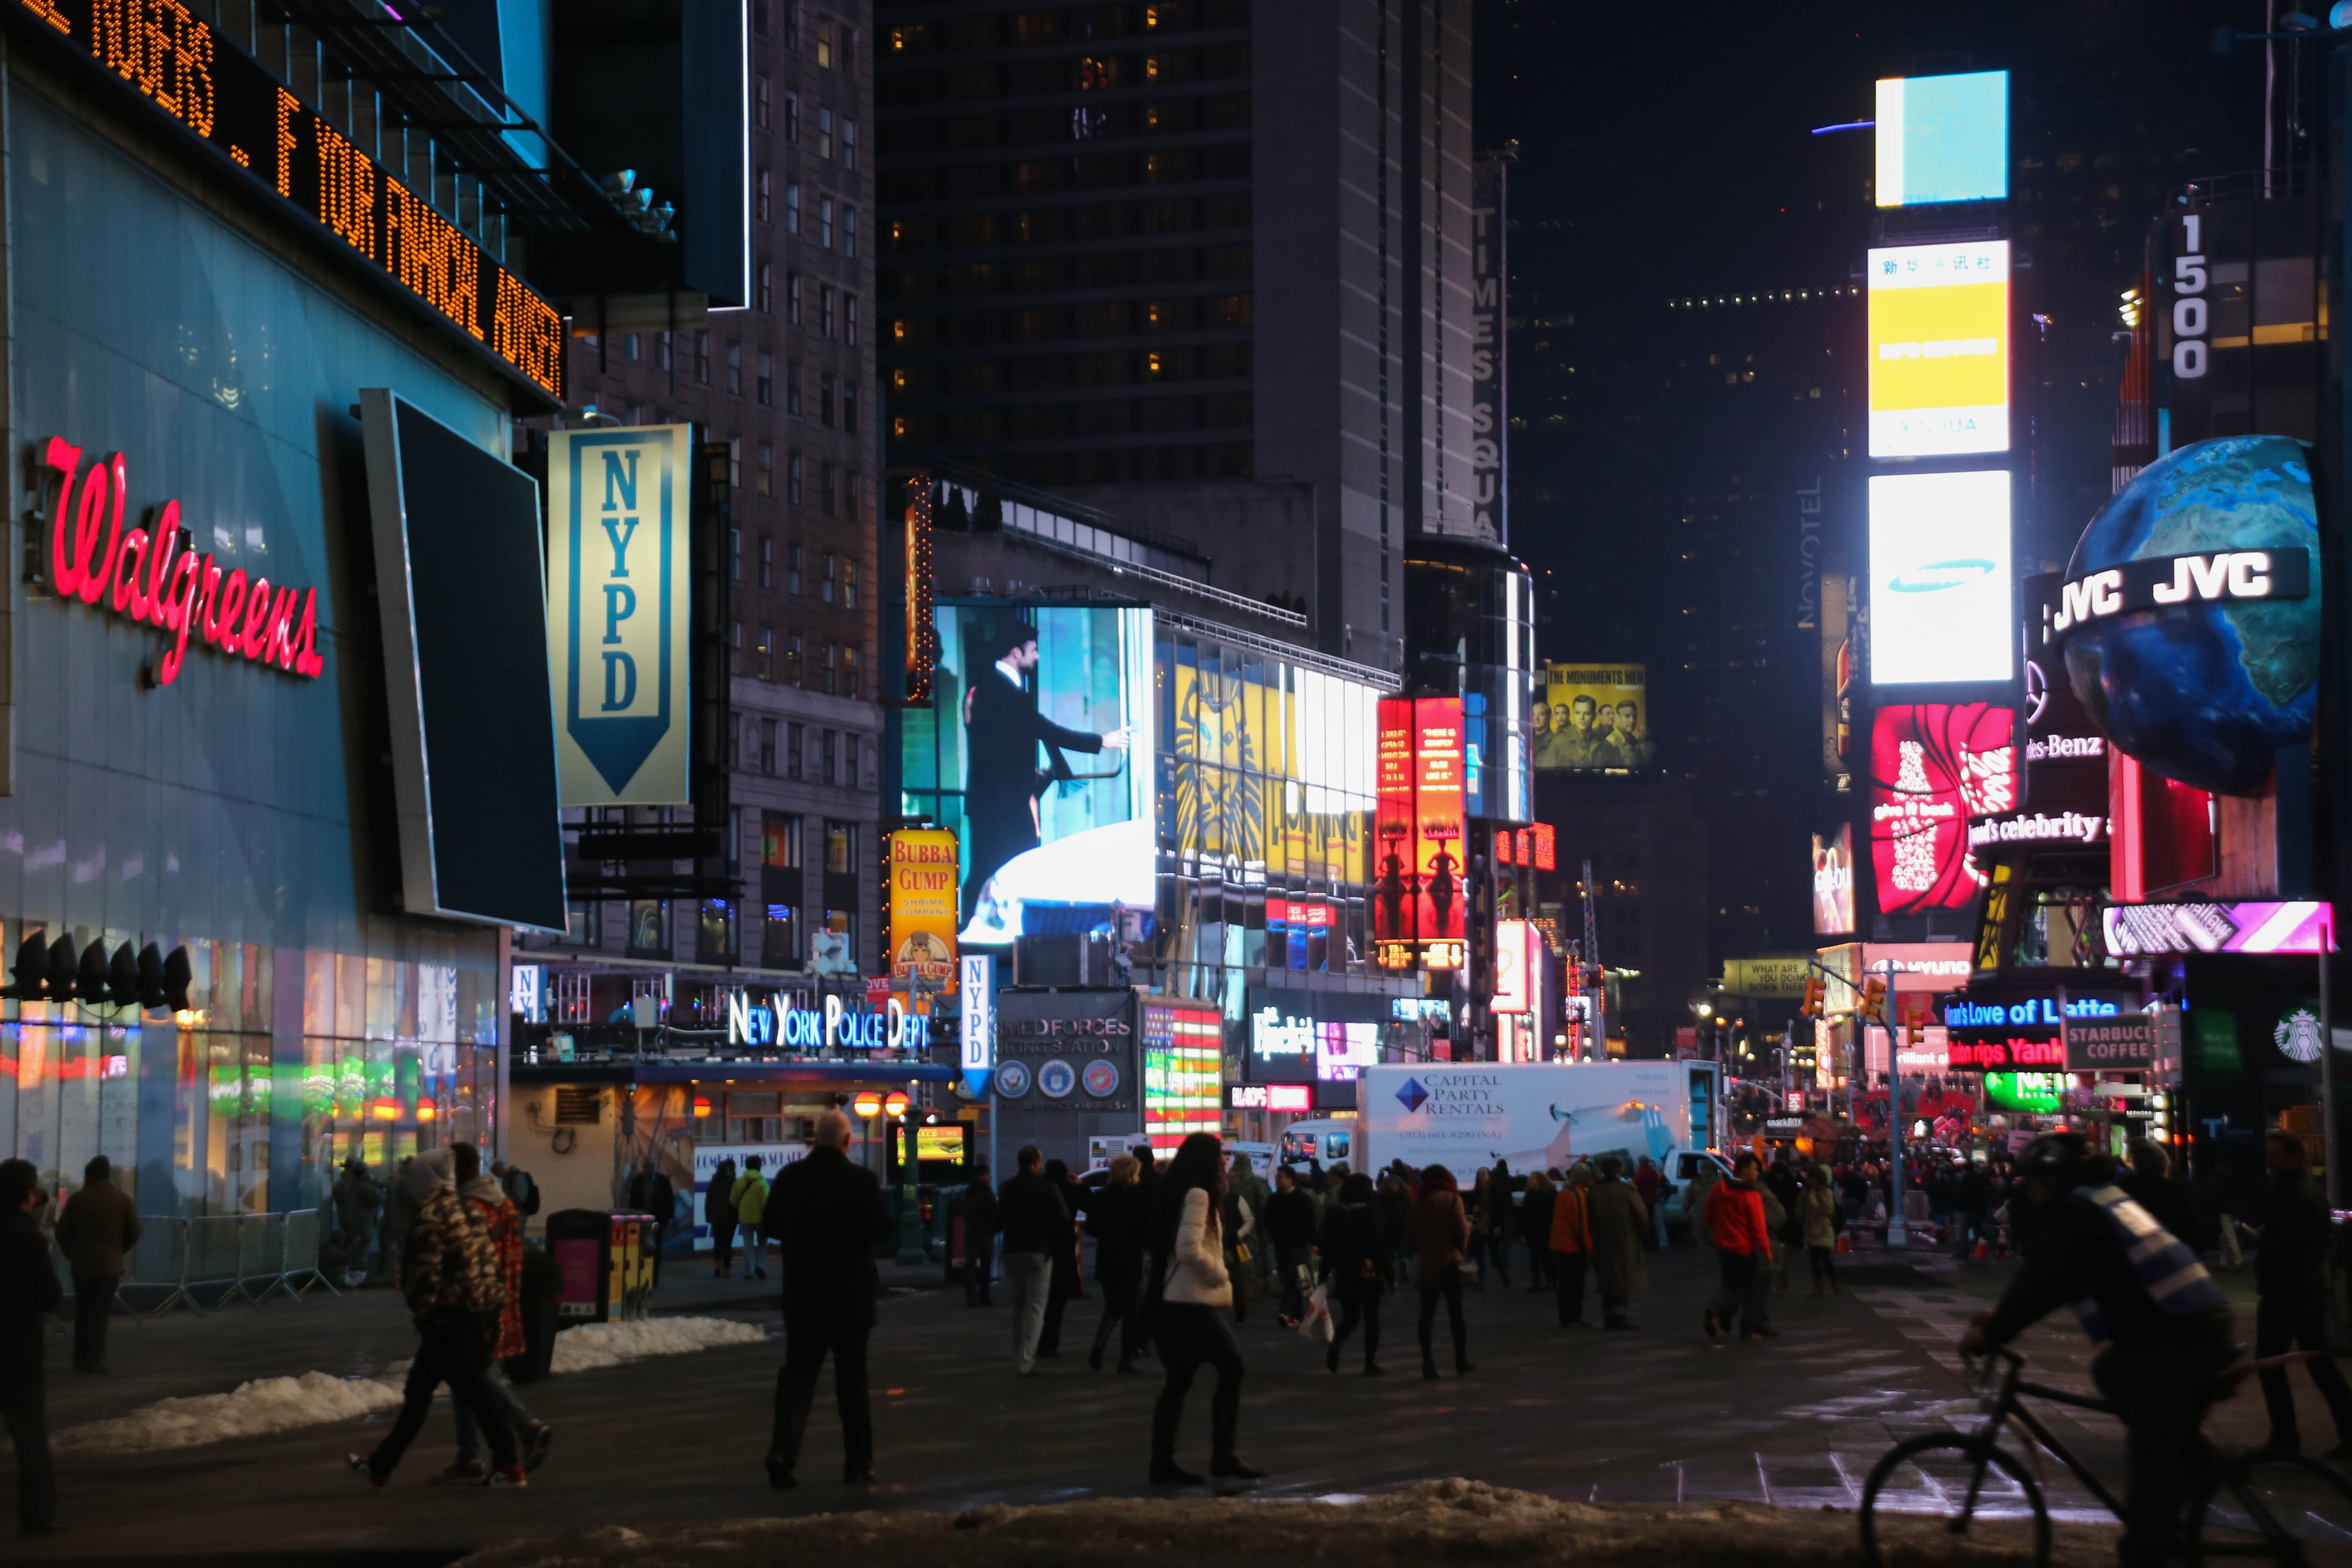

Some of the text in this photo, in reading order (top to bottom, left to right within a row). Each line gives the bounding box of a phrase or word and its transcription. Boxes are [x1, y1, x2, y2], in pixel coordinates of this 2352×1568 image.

[314, 116, 375, 260] YOUR
[386, 175, 484, 341] FINANCIAL
[1472, 208, 1497, 380] TIMES
[2174, 215, 2207, 378] 1500
[47, 436, 323, 685] Walgreens
[1797, 475, 1821, 628] NOVOTEL
[602, 450, 640, 712] NYPD
[2153, 552, 2269, 603] JVC
[2054, 570, 2122, 631] JVC
[1550, 670, 1644, 684] THE MONUMENTS MEN
[2000, 812, 2102, 842] celebrity
[894, 840, 952, 864] BUBBA
[899, 867, 949, 891] GUMP
[927, 962, 952, 976] GUMP
[1752, 965, 1798, 973] WHAT ARE
[1759, 974, 1809, 982] YOU DOING
[1749, 983, 1777, 991] DOWN
[729, 992, 928, 1048] NEW YORK POLICE DEPT
[969, 959, 982, 1063] NYPD
[1968, 1001, 2005, 1025] Love
[2009, 999, 2038, 1025] of
[1051, 1018, 1131, 1035] FORCES
[2087, 1042, 2148, 1058] COFFEE
[1424, 1074, 1501, 1086] CAPITAL
[1434, 1088, 1491, 1100] PARTY
[1426, 1103, 1504, 1115] RENTALS
[1767, 1118, 1802, 1127] snackBOX
